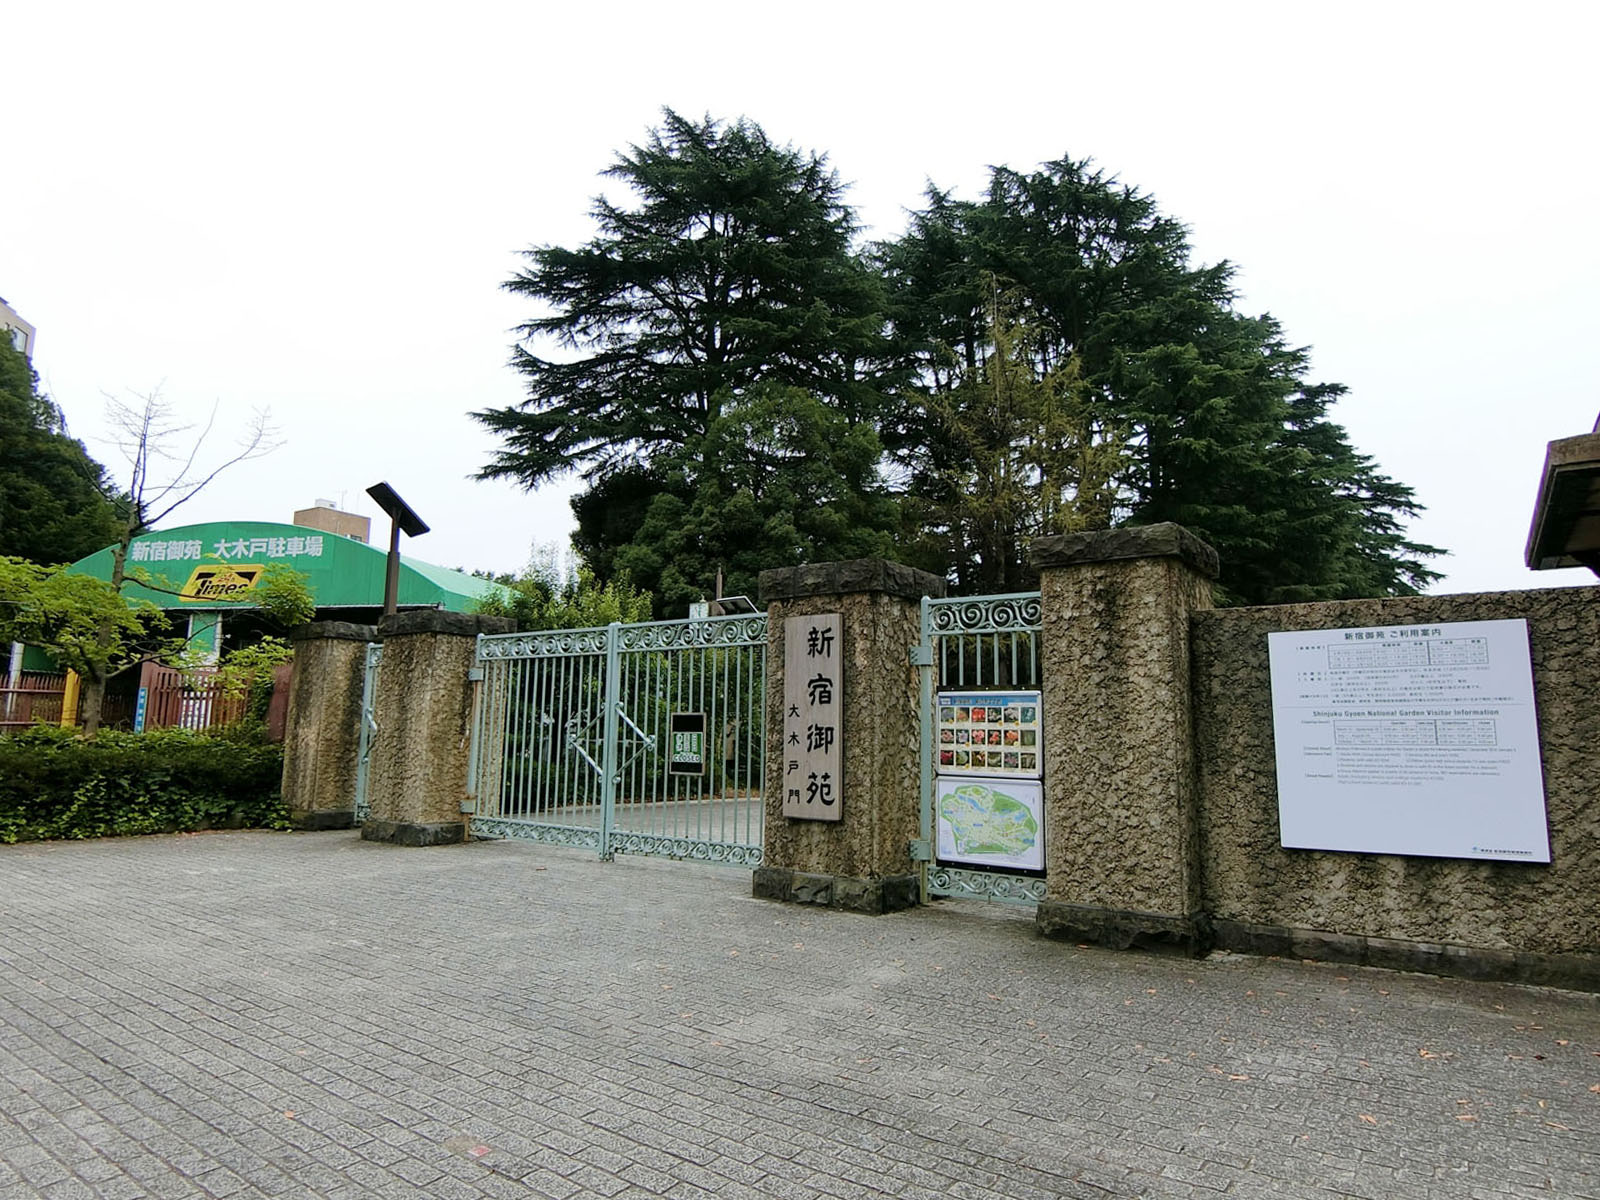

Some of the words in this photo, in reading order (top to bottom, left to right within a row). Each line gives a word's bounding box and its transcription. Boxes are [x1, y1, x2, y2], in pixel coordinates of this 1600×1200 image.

[132, 540, 202, 561] 新宿御苑
[213, 536, 323, 558] 大木戸駐車場
[194, 579, 249, 596] Times
[1344, 631, 1386, 640] 新宿御苑
[1389, 628, 1441, 639] ご利用案内
[807, 626, 835, 806] 新宿御苑
[1454, 708, 1499, 716] Information
[787, 704, 800, 804] 大木戸門
